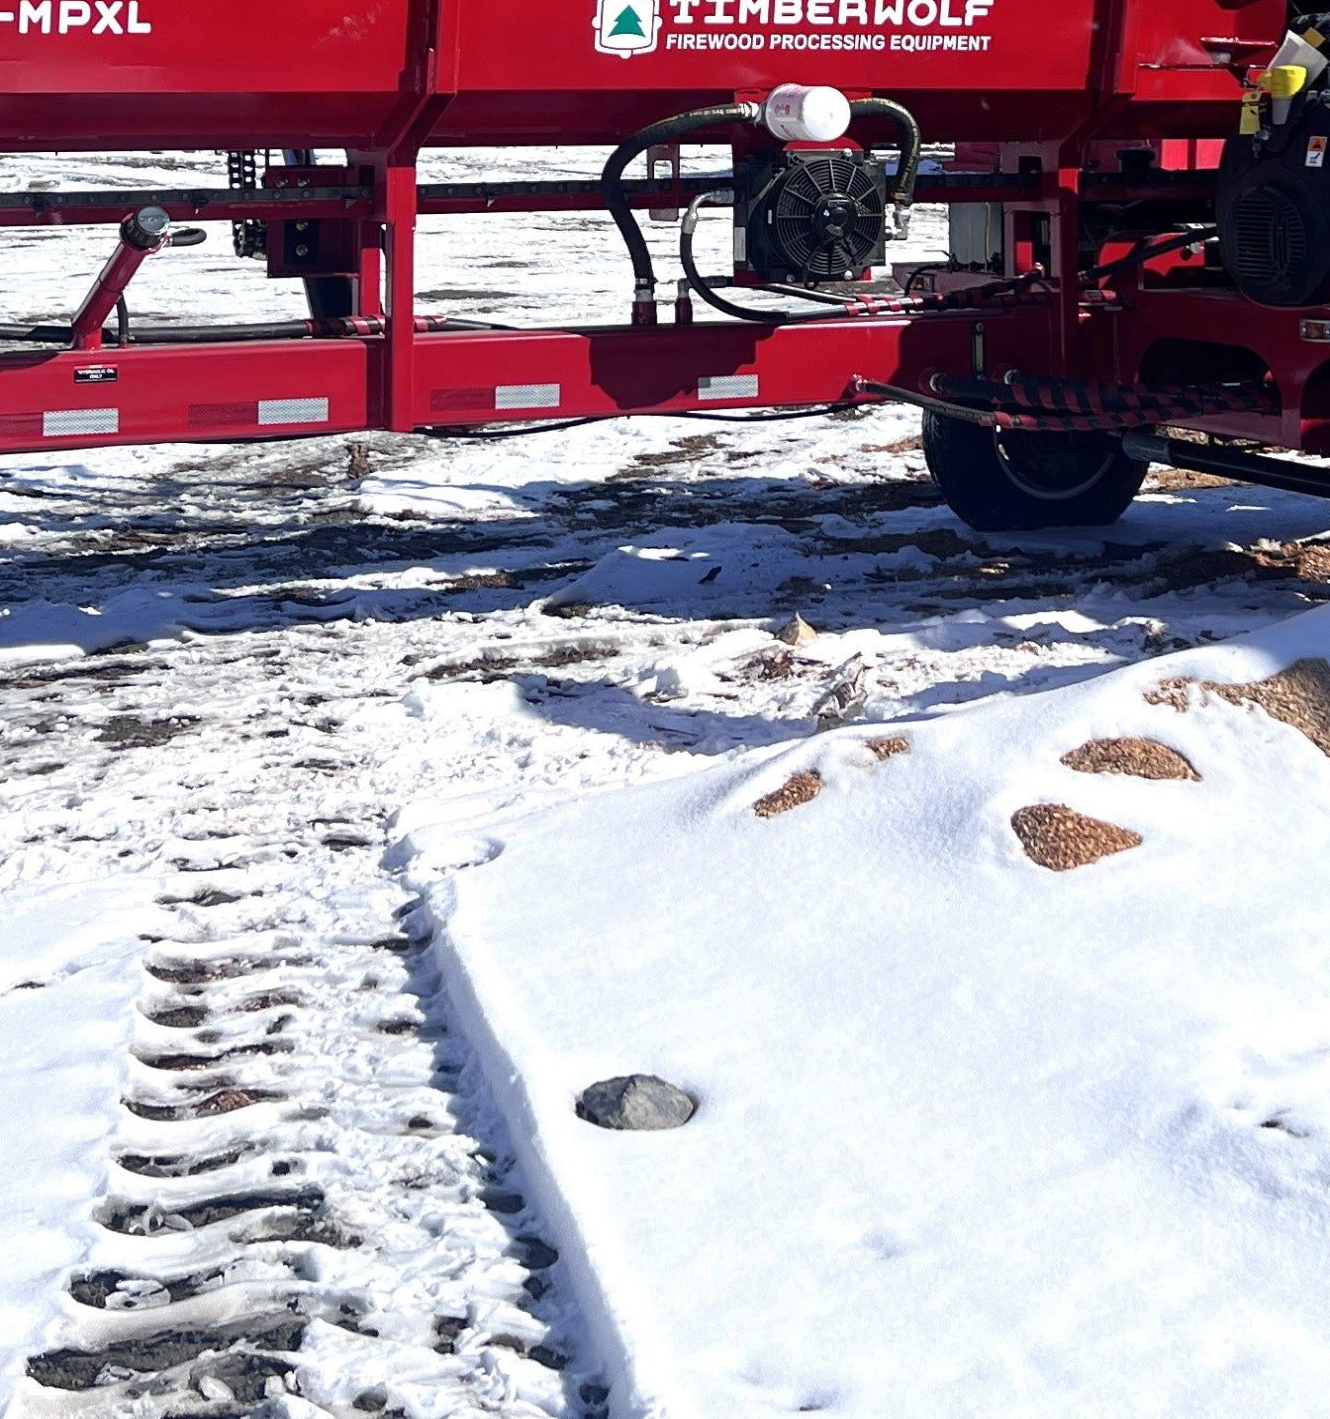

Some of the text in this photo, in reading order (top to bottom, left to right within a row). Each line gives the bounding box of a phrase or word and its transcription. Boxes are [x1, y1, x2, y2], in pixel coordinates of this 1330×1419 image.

[666, 33, 992, 52] FIREWOOD PROCESSING EQUIPMENT
